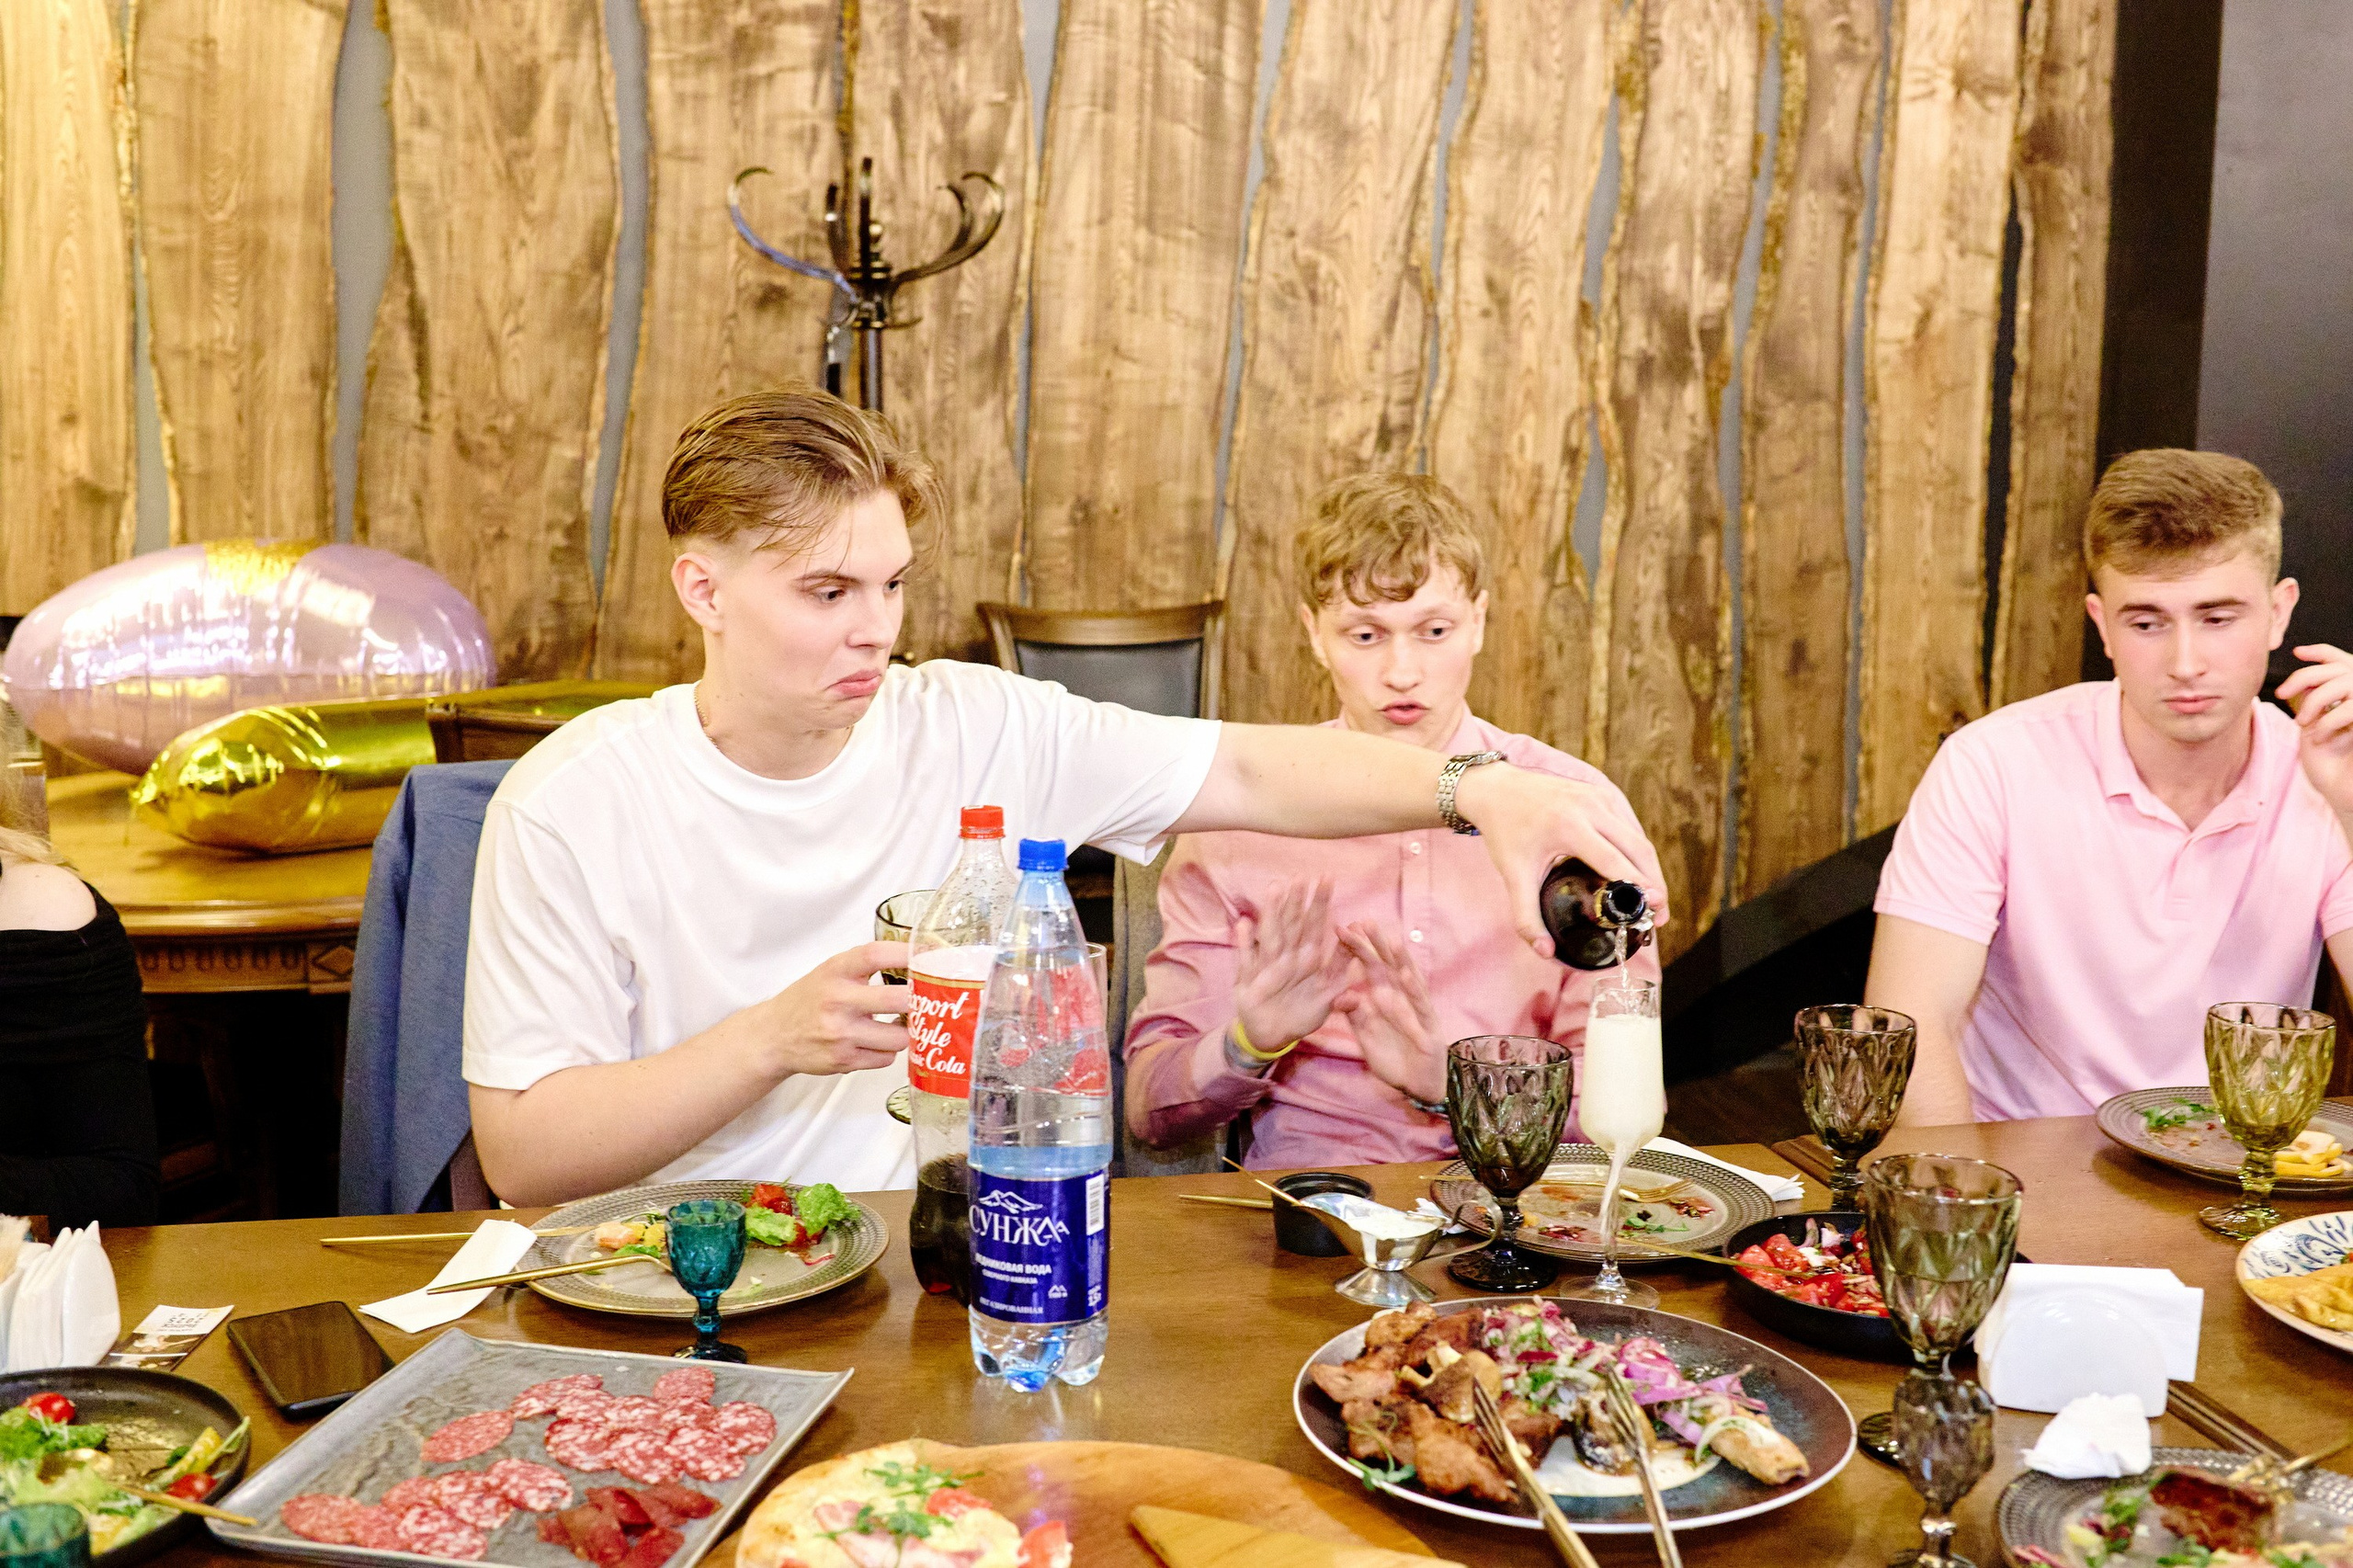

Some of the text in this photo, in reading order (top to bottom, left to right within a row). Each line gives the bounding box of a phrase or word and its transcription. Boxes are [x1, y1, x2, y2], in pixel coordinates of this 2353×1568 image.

[908, 1010, 951, 1051] Style
[926, 1047, 966, 1074] Cola
[1025, 1264, 1052, 1276] ВОДА
